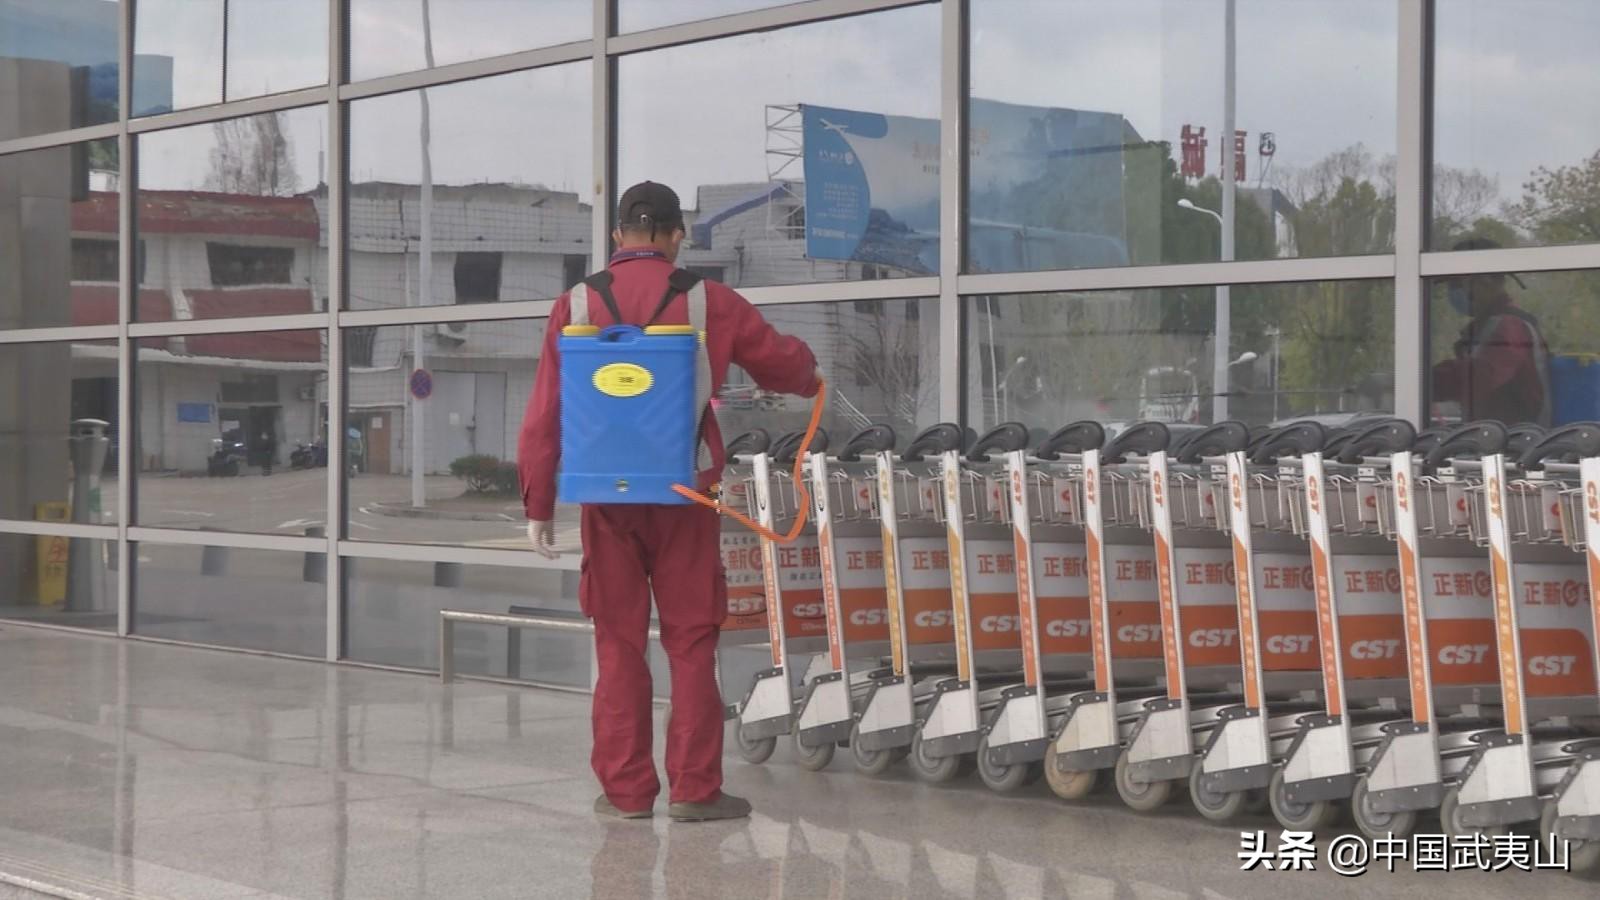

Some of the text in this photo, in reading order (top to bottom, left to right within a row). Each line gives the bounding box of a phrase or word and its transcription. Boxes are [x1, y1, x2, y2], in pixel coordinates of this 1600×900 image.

[1086, 468, 1096, 504] CST
[1154, 471, 1164, 507] CST
[1232, 474, 1243, 511] CST
[1309, 475, 1320, 513] CST
[1397, 472, 1408, 512] CST
[1587, 481, 1600, 523] CST
[977, 554, 1014, 574] 正新
[1043, 557, 1080, 577] 正新
[1116, 560, 1152, 580] 正新
[1185, 563, 1223, 585] 正新
[1263, 567, 1300, 589] 正新
[1344, 570, 1385, 593] 正新
[1432, 573, 1474, 596] 正新
[1523, 581, 1562, 605] 正新
[1046, 619, 1091, 637] CST
[1117, 624, 1162, 642] CST
[1189, 628, 1237, 647] CST
[1266, 635, 1314, 654] CST
[1350, 640, 1400, 660] CST
[1438, 644, 1489, 665] CST
[1528, 655, 1576, 676] CST
